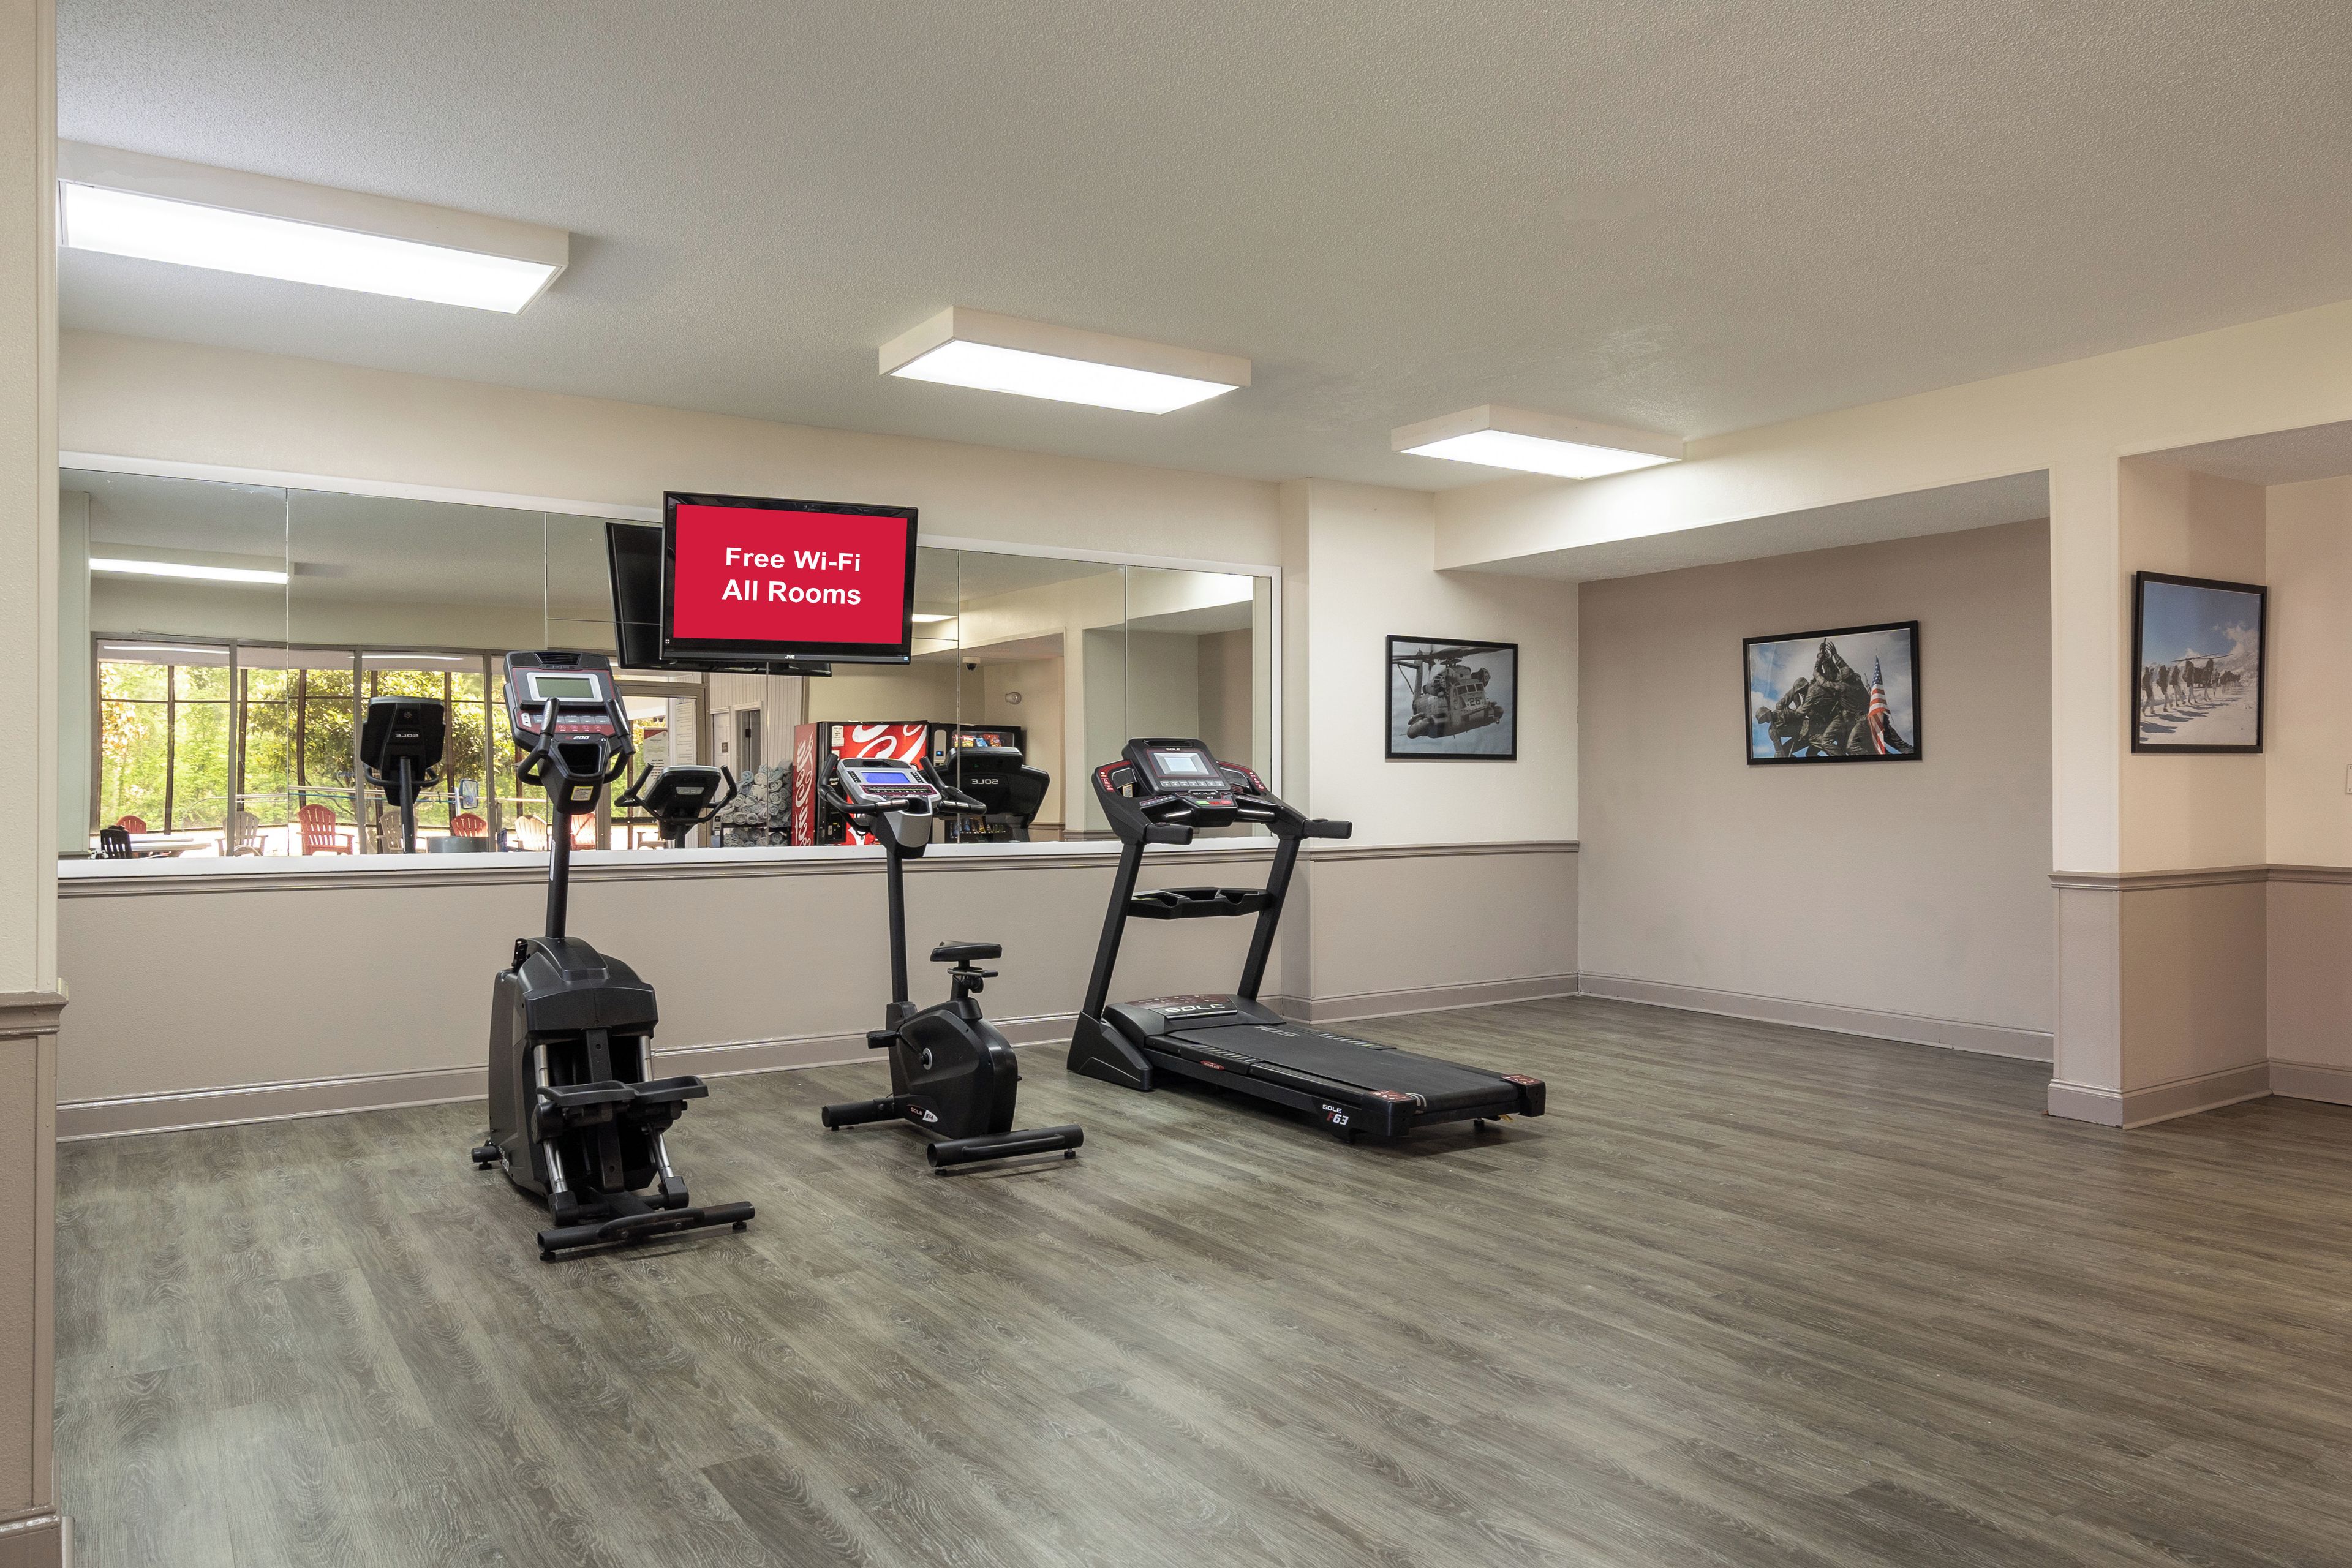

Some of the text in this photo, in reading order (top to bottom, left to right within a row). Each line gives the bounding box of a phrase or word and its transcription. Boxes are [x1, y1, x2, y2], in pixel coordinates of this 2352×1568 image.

[726, 547, 861, 572] Free Wi-Fi
[722, 579, 861, 605] All Rooms
[1469, 696, 1482, 706] 26
[1164, 1003, 1226, 1013] SOLE
[910, 1107, 923, 1116] SOLE
[1322, 1104, 1343, 1114] SOLE
[1325, 1112, 1349, 1126] F63
